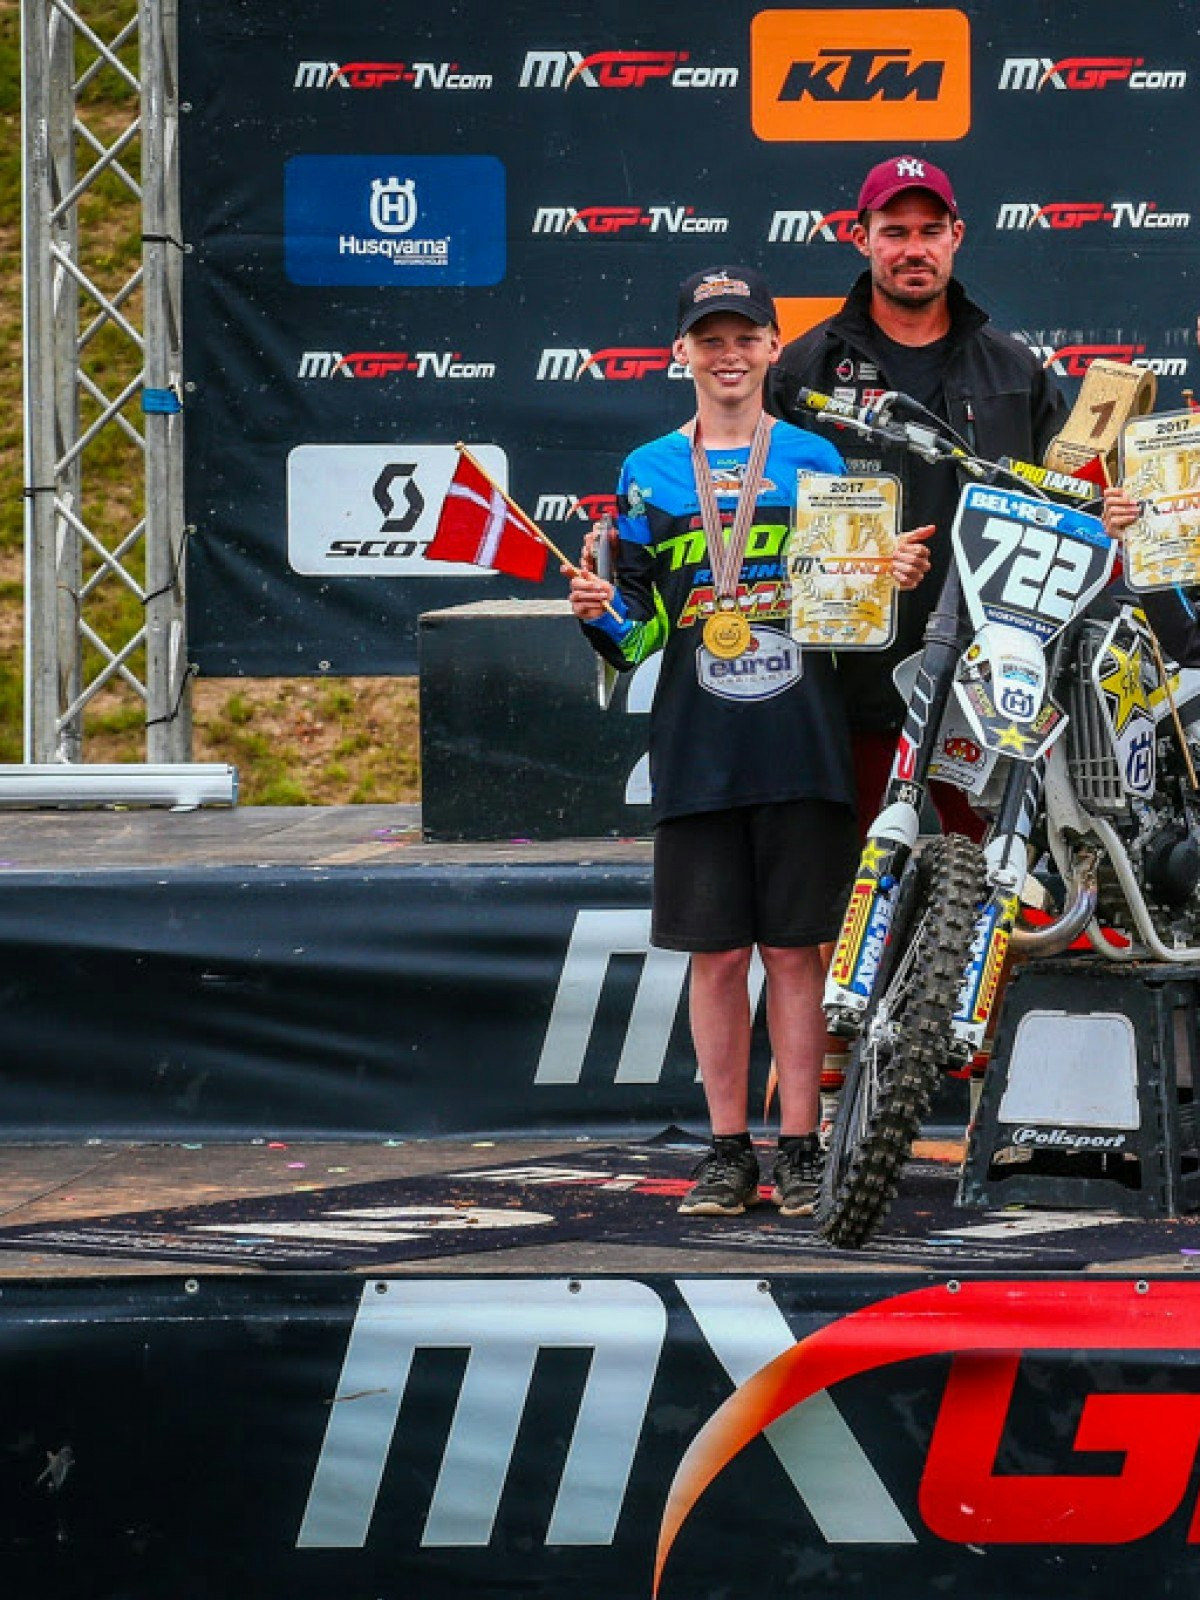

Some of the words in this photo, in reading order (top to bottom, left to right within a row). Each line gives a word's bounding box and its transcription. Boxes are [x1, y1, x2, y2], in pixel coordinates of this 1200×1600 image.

[777, 49, 945, 101] KTM
[339, 234, 449, 258] Husqvarna
[1089, 401, 1117, 439] 1
[1155, 420, 1189, 435] 2017
[830, 483, 864, 493] 2017
[982, 517, 1094, 622] 722
[709, 649, 793, 677] eurol
[1018, 1128, 1126, 1148] Polisport
